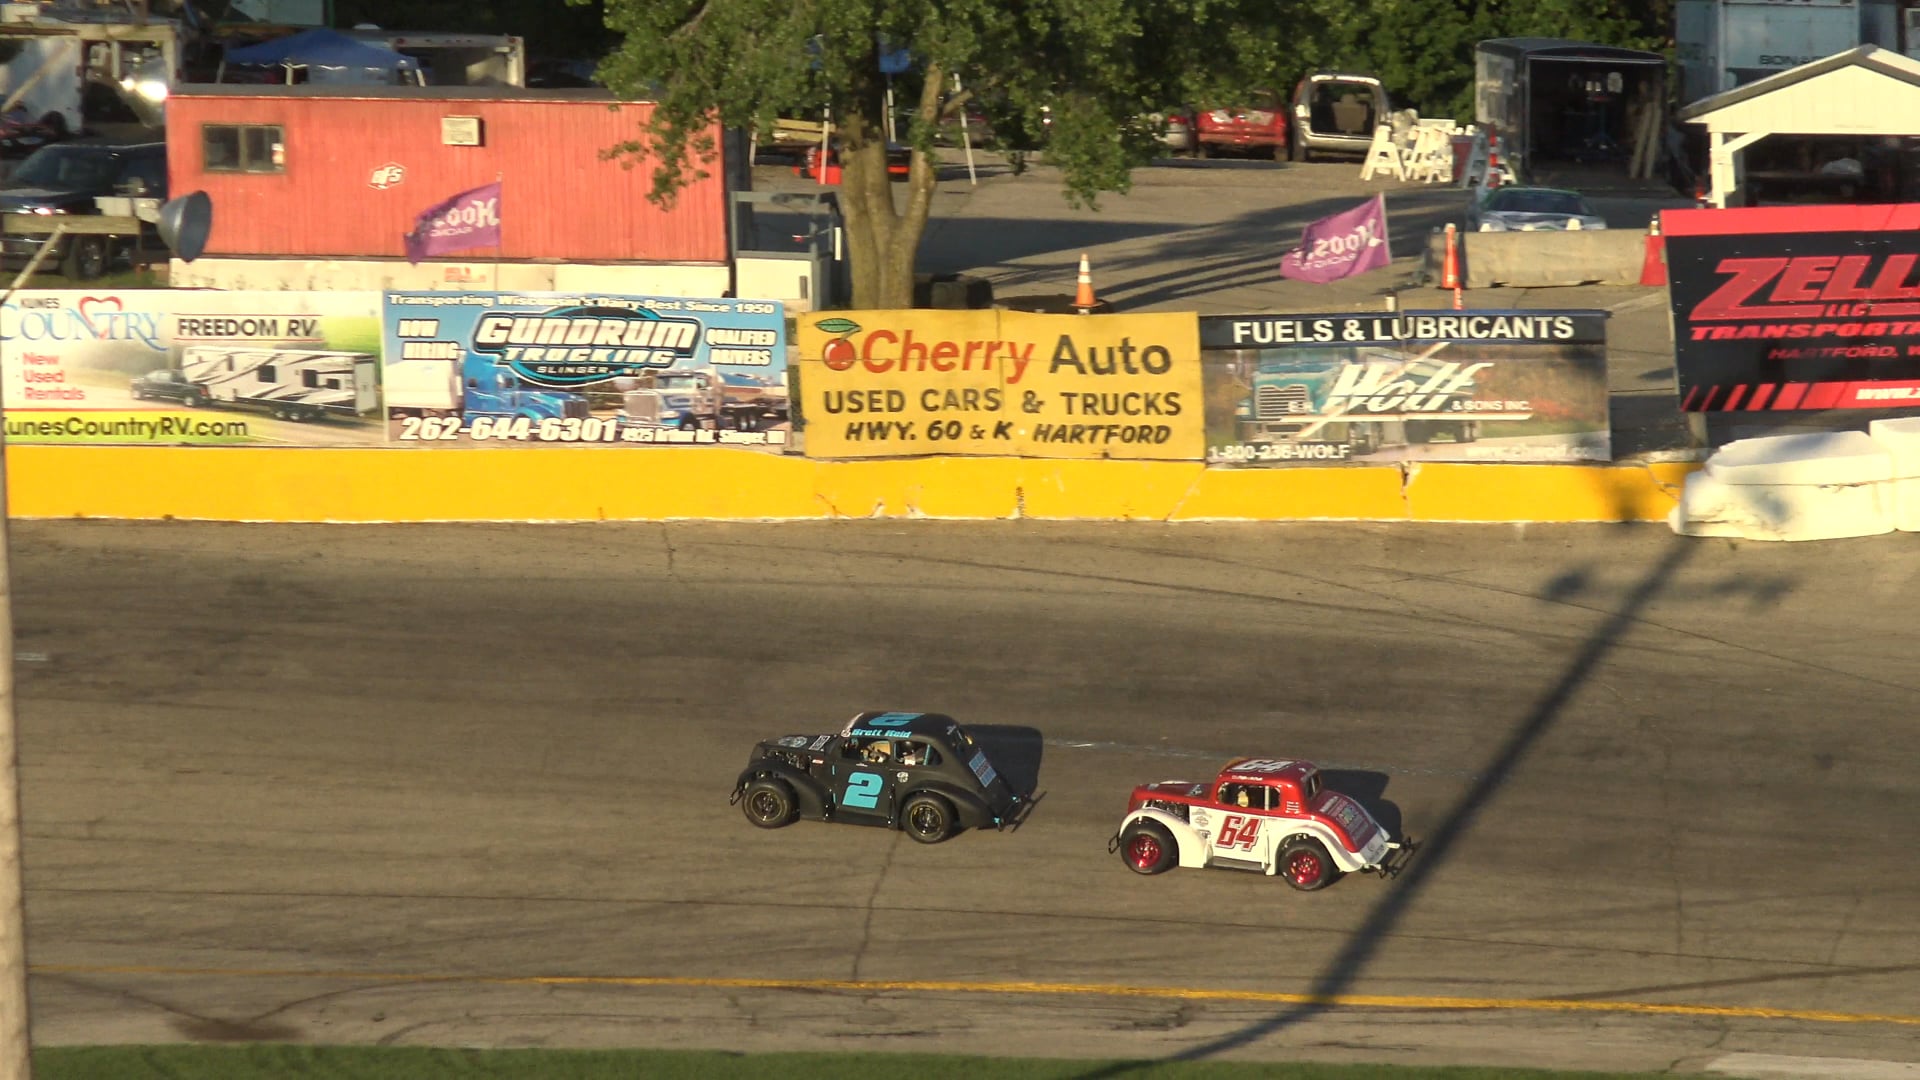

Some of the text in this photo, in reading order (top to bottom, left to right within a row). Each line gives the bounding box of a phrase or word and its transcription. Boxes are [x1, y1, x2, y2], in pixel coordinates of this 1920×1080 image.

[388, 294, 494, 307] Transporting
[497, 295, 595, 308] Wisconsin's
[685, 301, 731, 312] Since
[735, 303, 775, 314] 1950
[1825, 303, 1868, 317] LLC
[177, 317, 318, 338] FREEDOM RV
[476, 316, 698, 349] GUNDRUM
[1233, 315, 1575, 344] FUELS & LUBRICANTS
[22, 352, 59, 365] New
[501, 346, 676, 364] TRUCKING
[861, 329, 1173, 385] Cherry Auto
[1768, 346, 1899, 360] HARTFORD,
[23, 369, 65, 383] Used
[1322, 360, 1495, 414] Wolf
[1463, 400, 1504, 411] SONS
[24, 387, 86, 401] Rentals
[824, 387, 1182, 417] USED CARS & TRUCKS
[399, 417, 618, 442] 262-644-6301
[844, 420, 1172, 445] HWY. 60 & K HARTFORD
[842, 771, 884, 809] 2
[1215, 814, 1264, 852] 64
